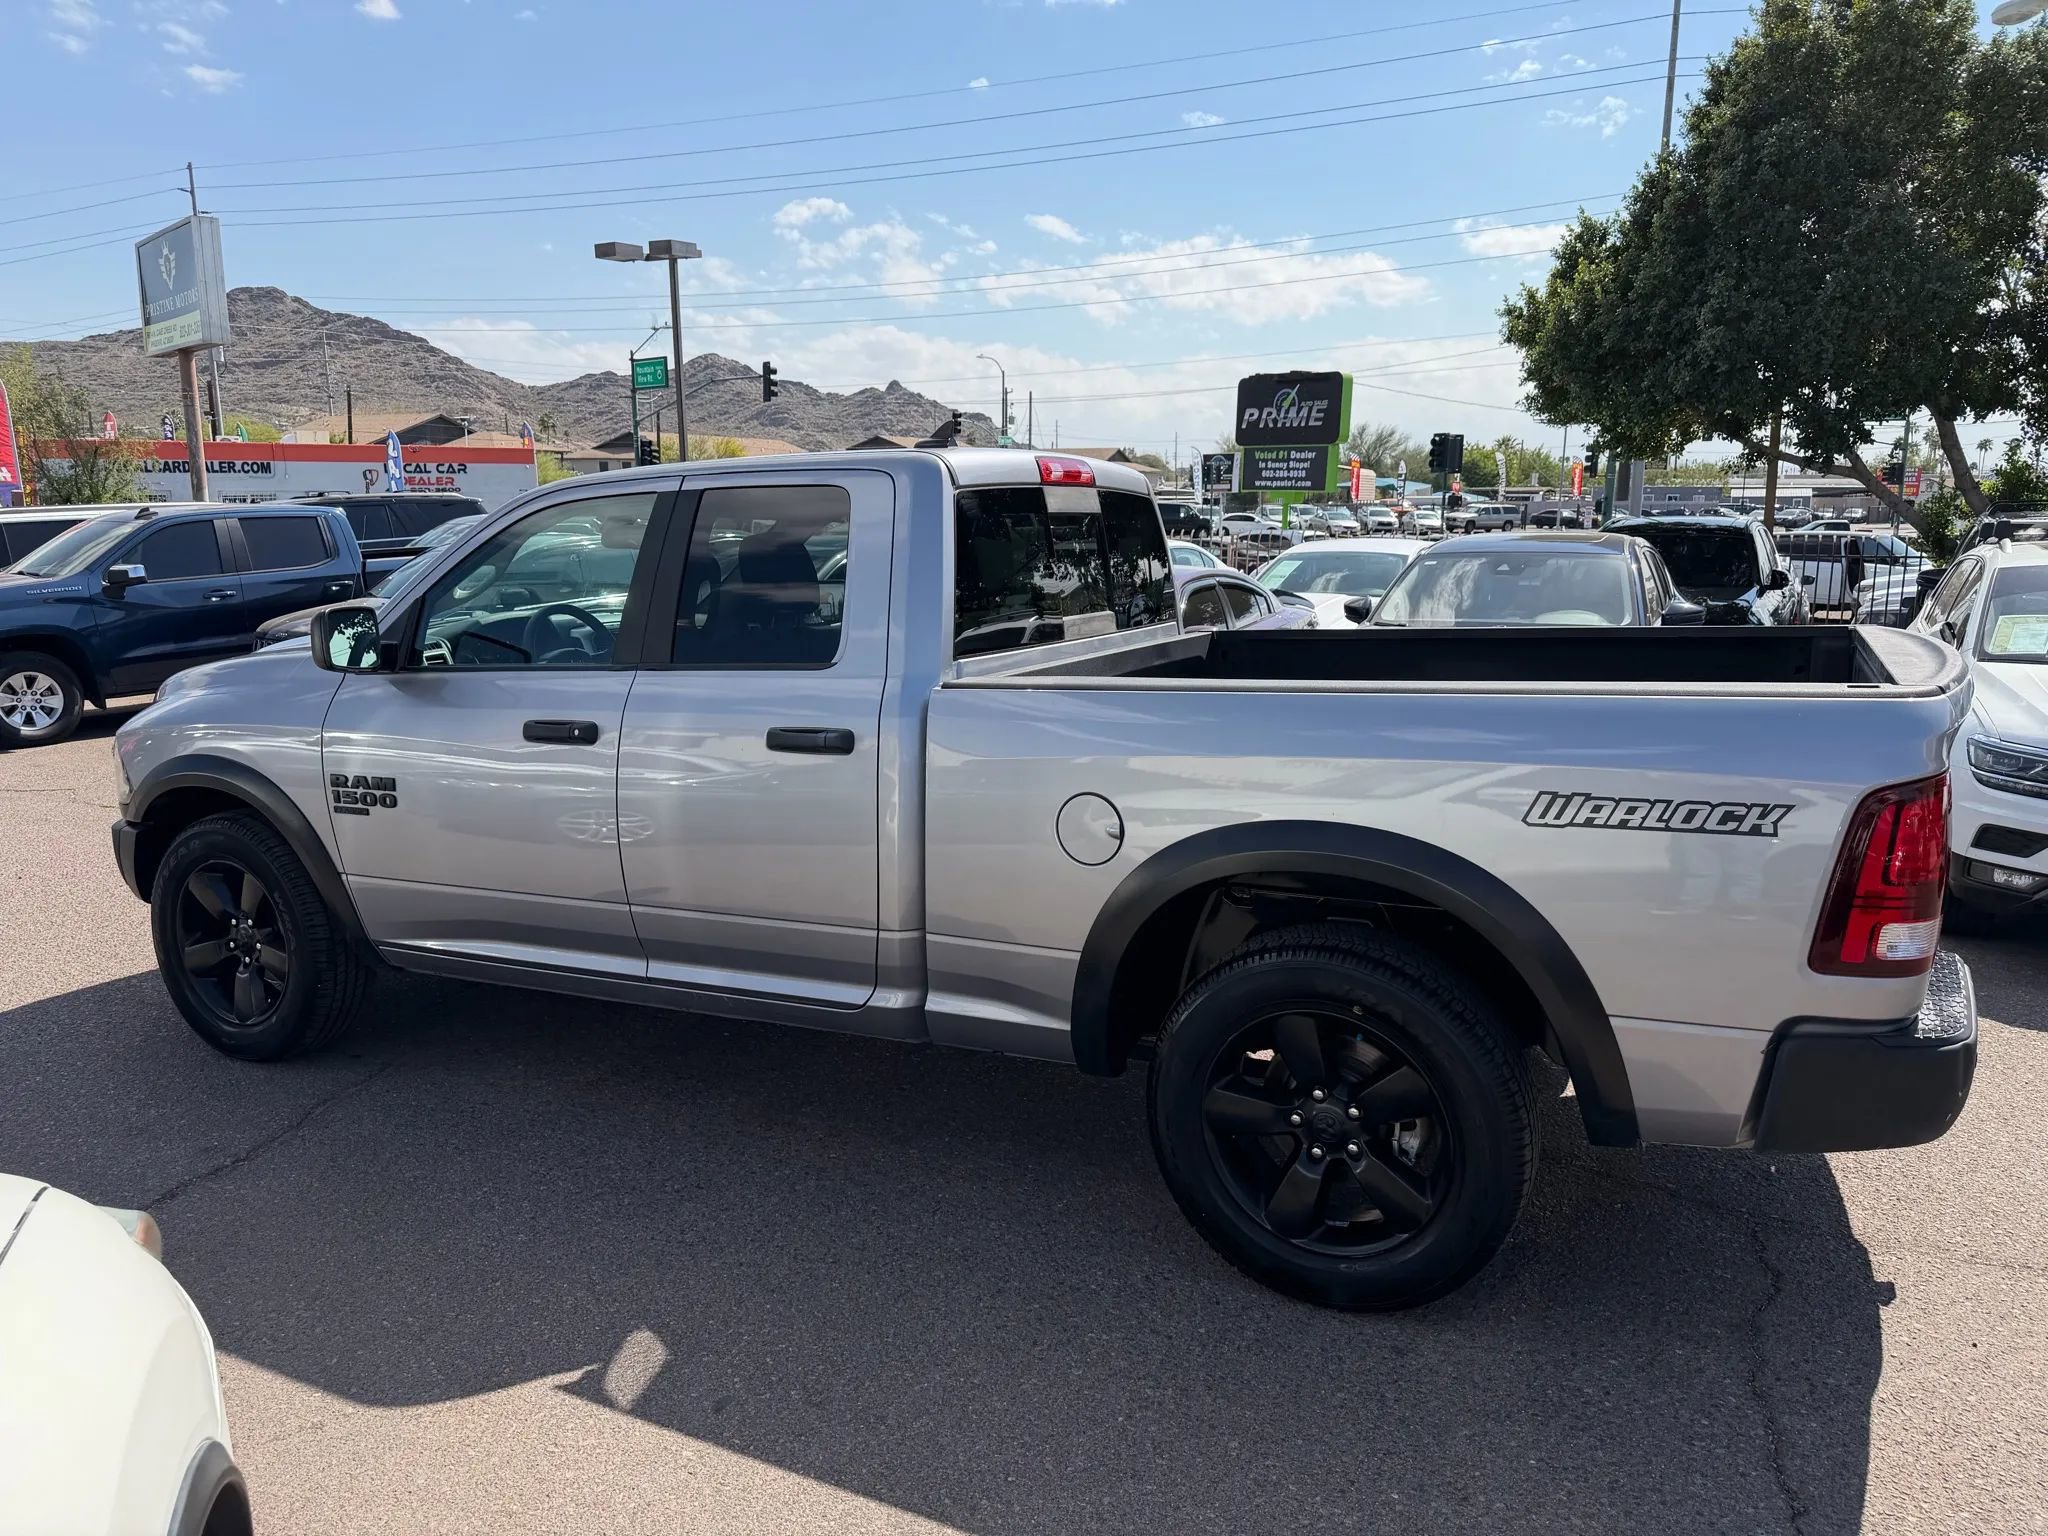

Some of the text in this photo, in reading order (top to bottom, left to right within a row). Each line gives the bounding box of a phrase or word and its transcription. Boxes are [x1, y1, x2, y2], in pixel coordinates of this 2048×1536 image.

[146, 287, 200, 318] PRISTINE MOTORS
[636, 366, 655, 374] Mountain
[1241, 406, 1328, 429] PRIME
[1254, 450, 1278, 460] Voted
[1290, 450, 1317, 459] Dealer
[436, 463, 468, 474] CAR
[1267, 460, 1288, 470] Sunny
[1254, 479, 1312, 488] www.pauto1.com
[26, 585, 82, 595] SILVERADO
[330, 773, 397, 793] RAM
[331, 789, 398, 808] 1500
